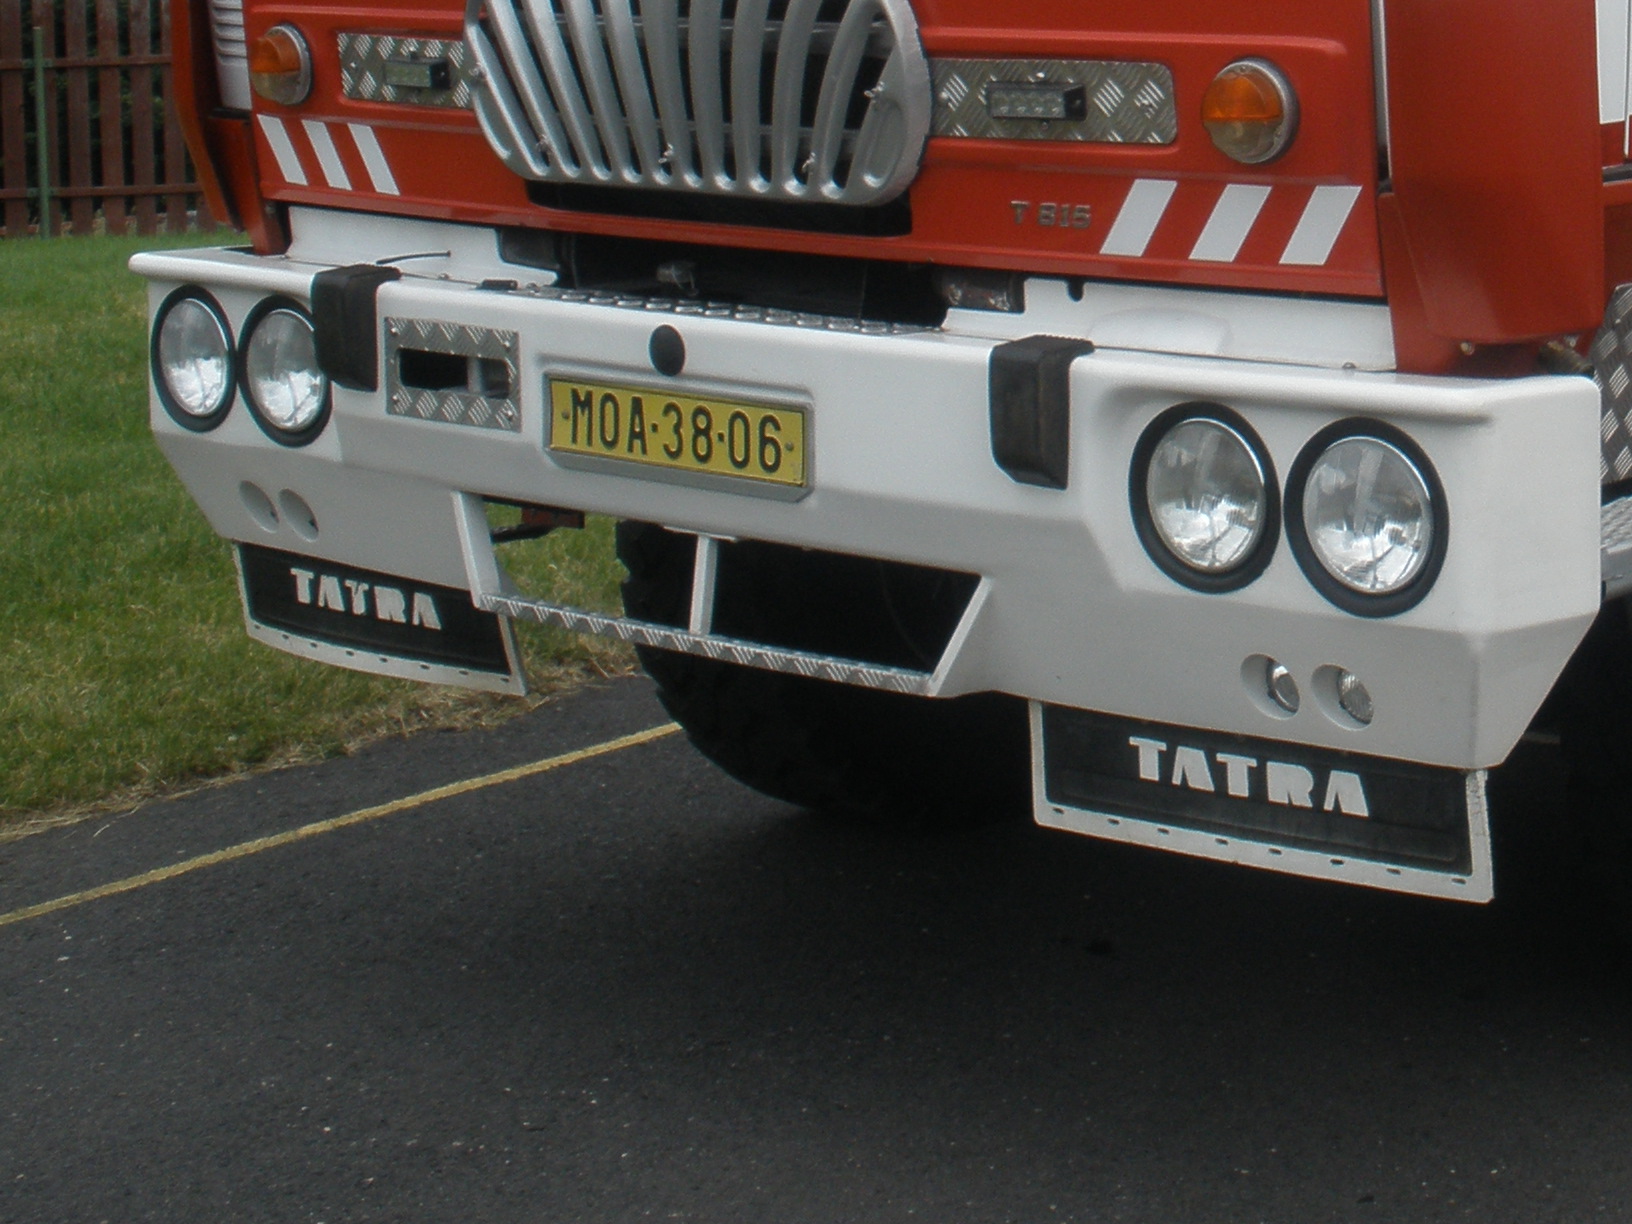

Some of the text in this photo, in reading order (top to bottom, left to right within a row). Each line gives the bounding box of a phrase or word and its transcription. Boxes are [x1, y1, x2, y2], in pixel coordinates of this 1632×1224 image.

[1010, 200, 1091, 229] T 815
[291, 567, 441, 631] TATRA
[1129, 736, 1369, 817] TATRA
